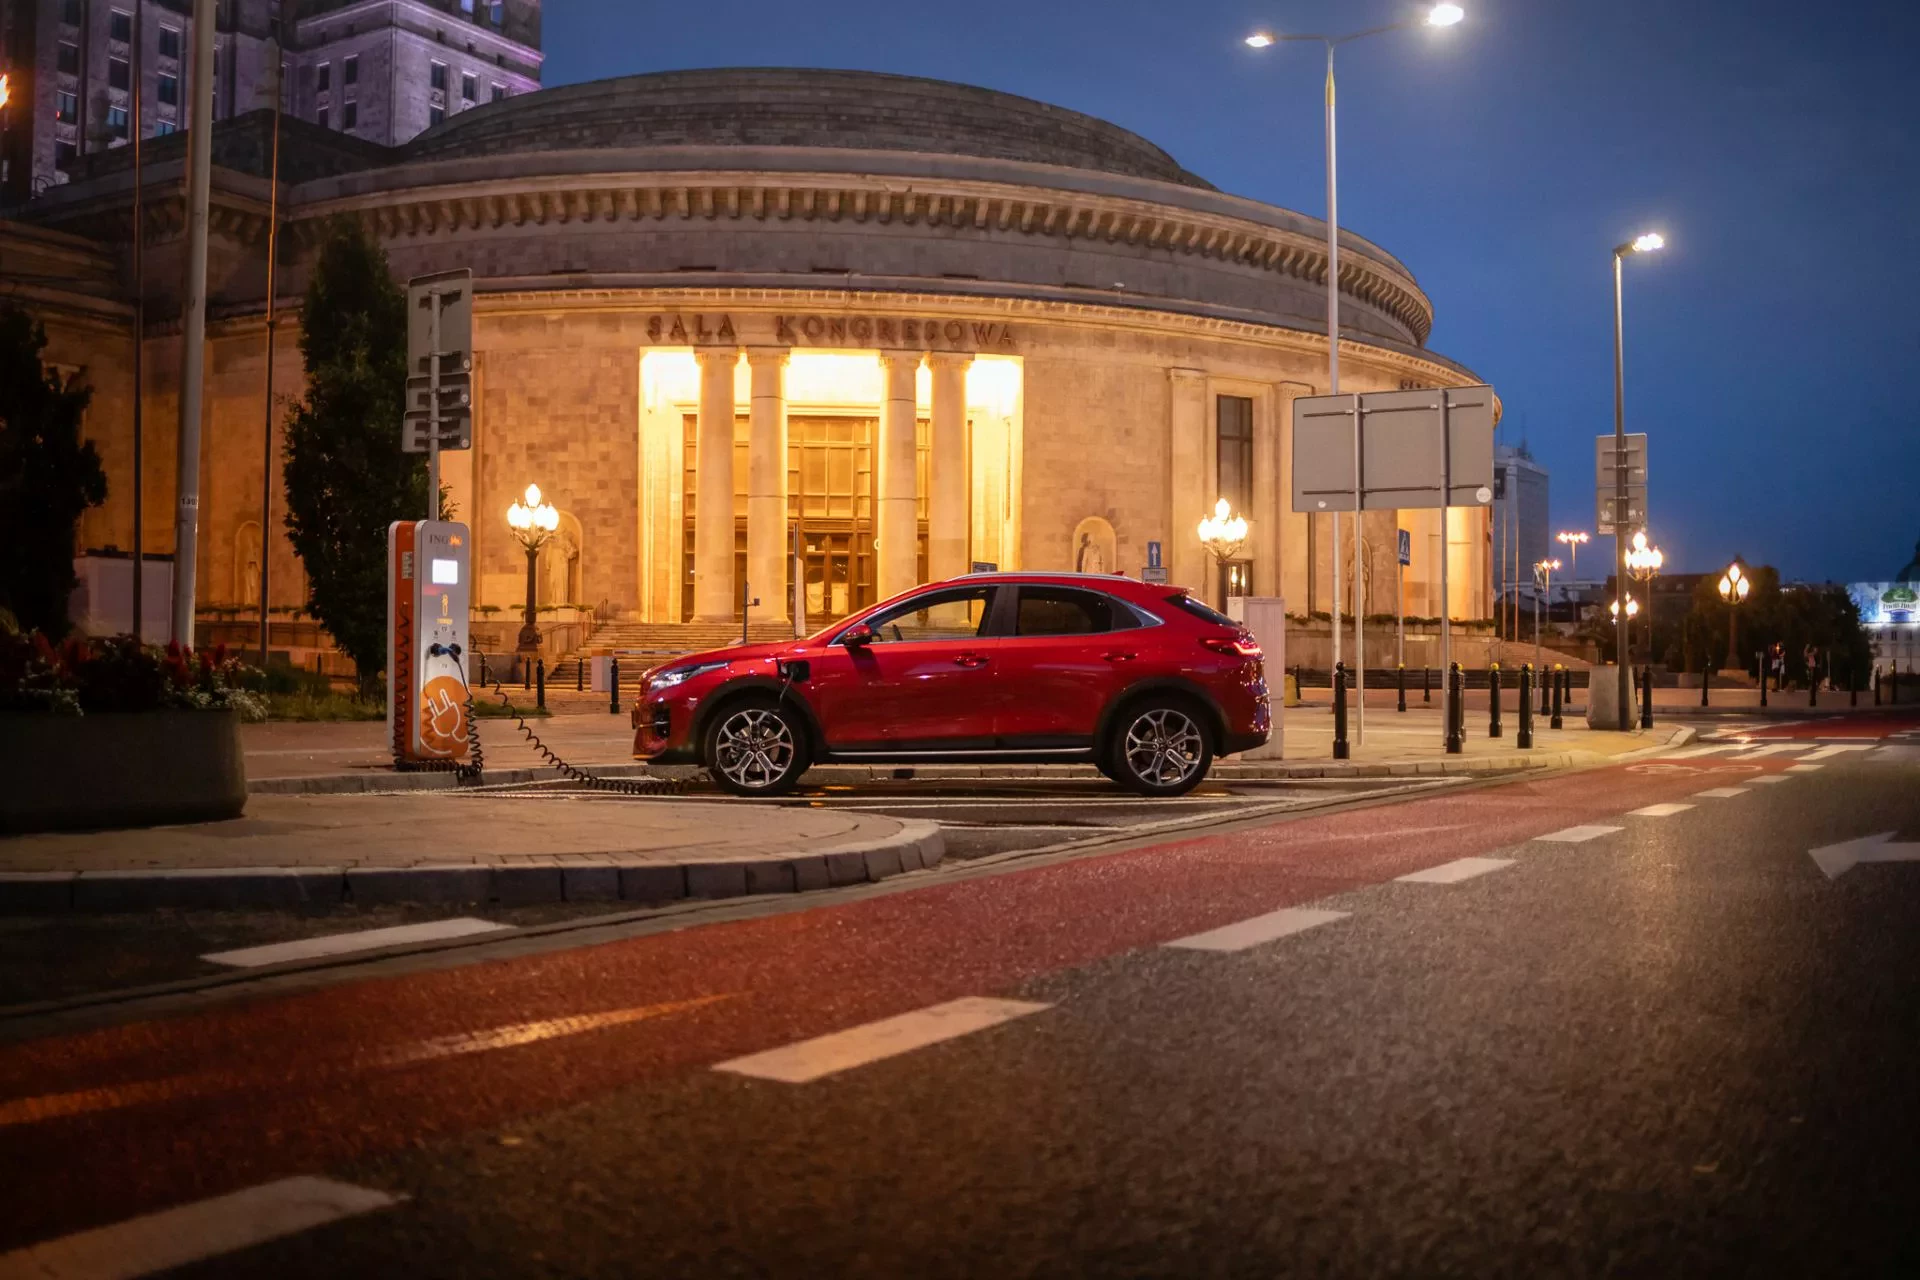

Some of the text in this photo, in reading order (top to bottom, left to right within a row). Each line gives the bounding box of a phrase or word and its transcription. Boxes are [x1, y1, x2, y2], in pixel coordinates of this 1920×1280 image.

[647, 314, 1016, 345] SALA KONGRESOWA
[429, 534, 448, 545] ING
